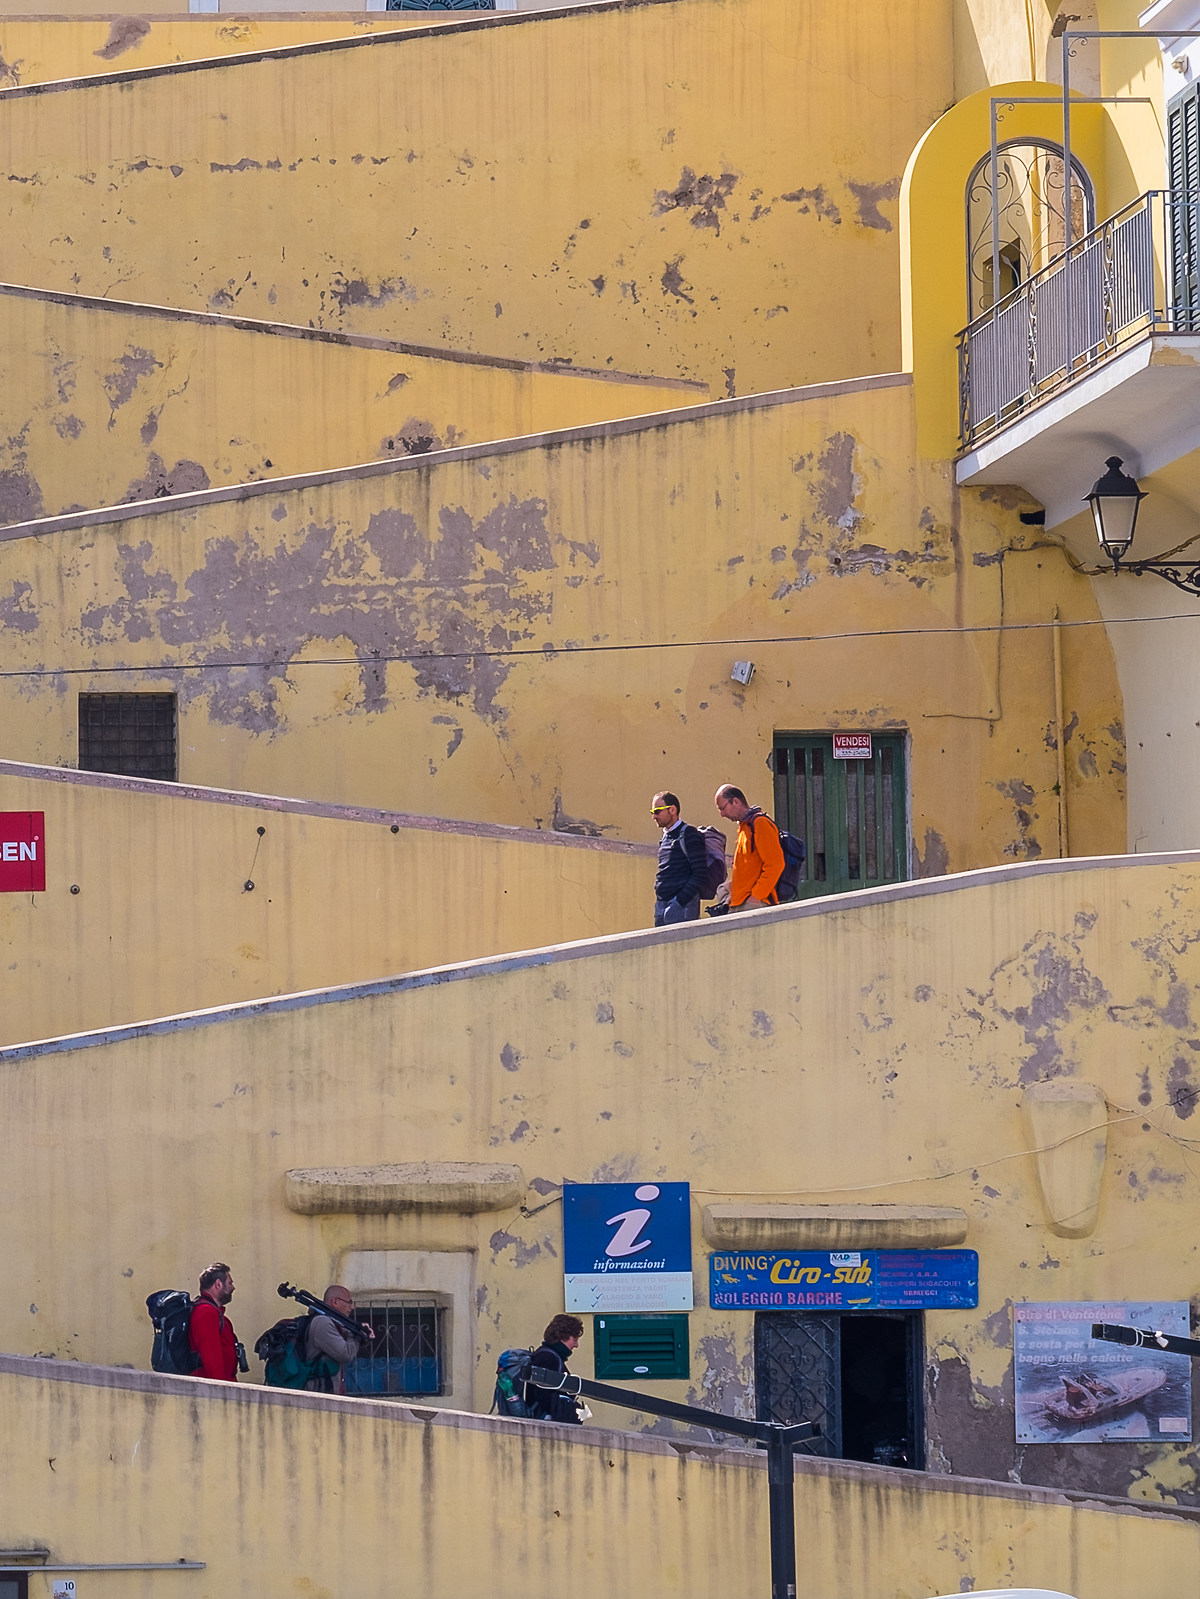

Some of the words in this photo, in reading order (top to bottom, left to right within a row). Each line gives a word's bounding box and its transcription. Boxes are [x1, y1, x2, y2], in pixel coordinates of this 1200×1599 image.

[836, 737, 869, 746] VENDESI
[593, 1258, 666, 1272] informazioni
[714, 1256, 768, 1270] DIVING
[787, 1292, 843, 1305] BARCHE
[1017, 1310, 1042, 1320] Giro
[1045, 1310, 1057, 1320] di
[1018, 1325, 1029, 1335] S.
[1029, 1340, 1062, 1349] sosta
[1064, 1341, 1085, 1351] per
[1018, 1353, 1055, 1365] bagno
[1058, 1353, 1088, 1363] nelle
[1090, 1353, 1134, 1363] calette
[64, 1581, 75, 1591] 10
